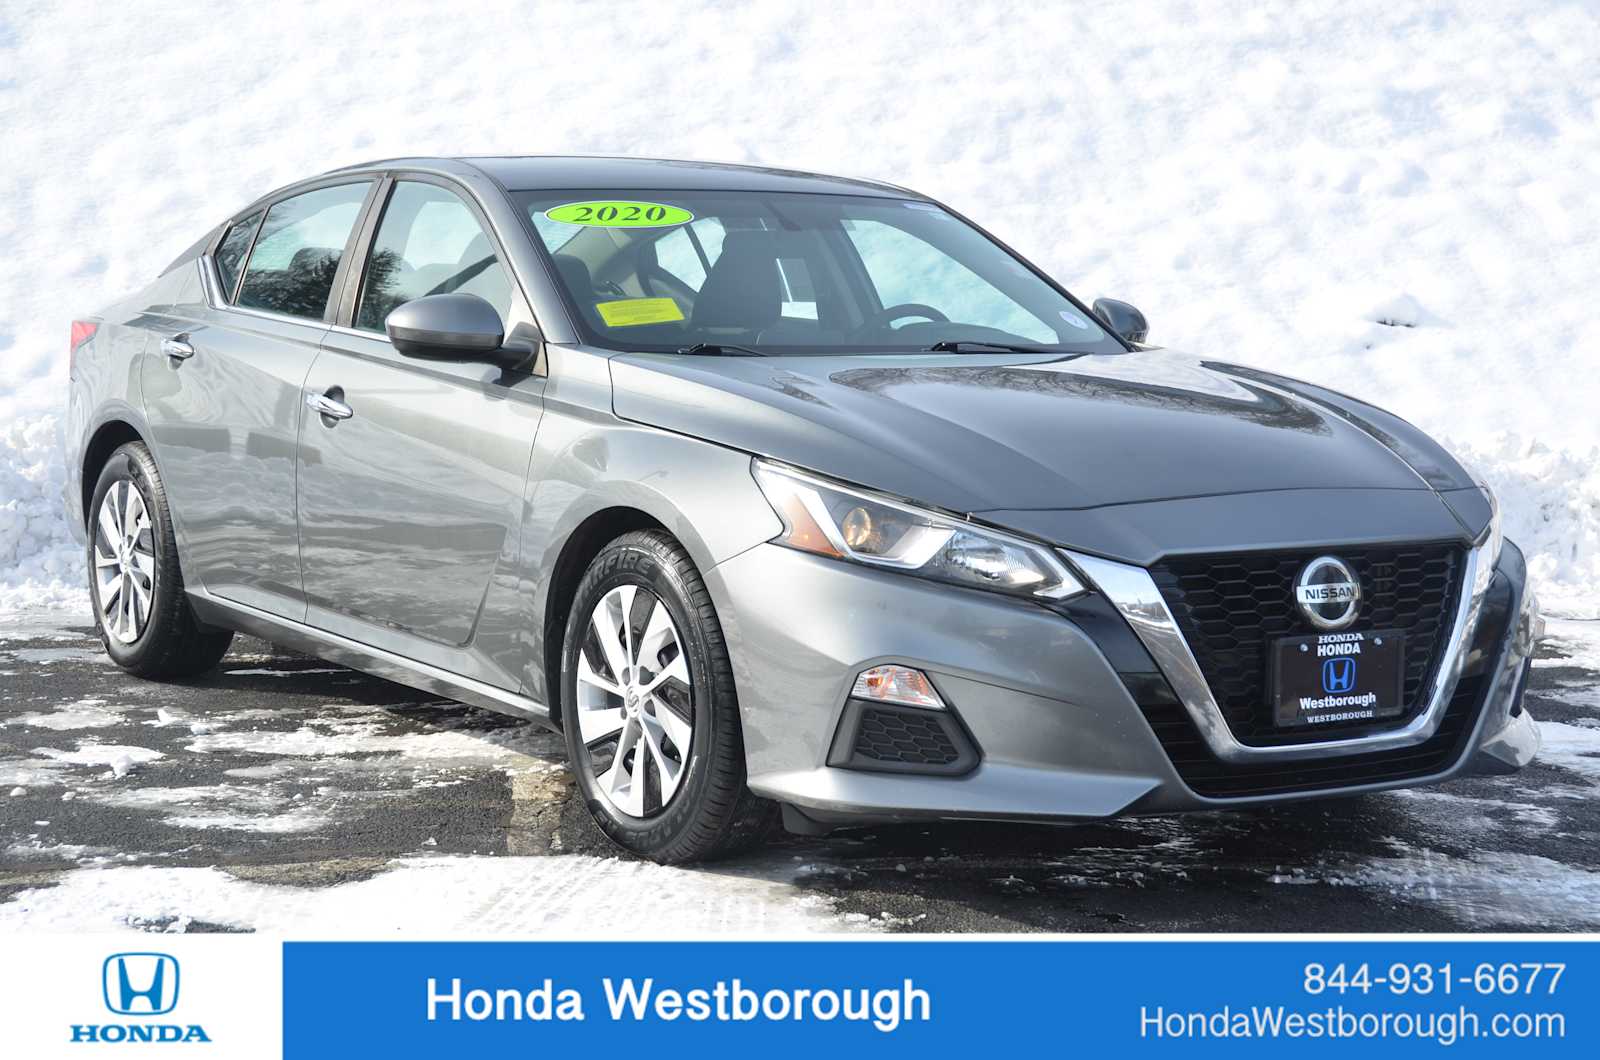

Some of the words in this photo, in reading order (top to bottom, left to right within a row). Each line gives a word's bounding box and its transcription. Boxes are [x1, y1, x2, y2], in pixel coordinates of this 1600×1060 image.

[573, 206, 666, 221] 2020
[1304, 587, 1356, 600] NISSAN
[1318, 633, 1365, 644] HONDA
[1317, 643, 1361, 656] HONDA
[1299, 692, 1377, 710] Westborough
[1307, 710, 1373, 723] WESTBOROUGH
